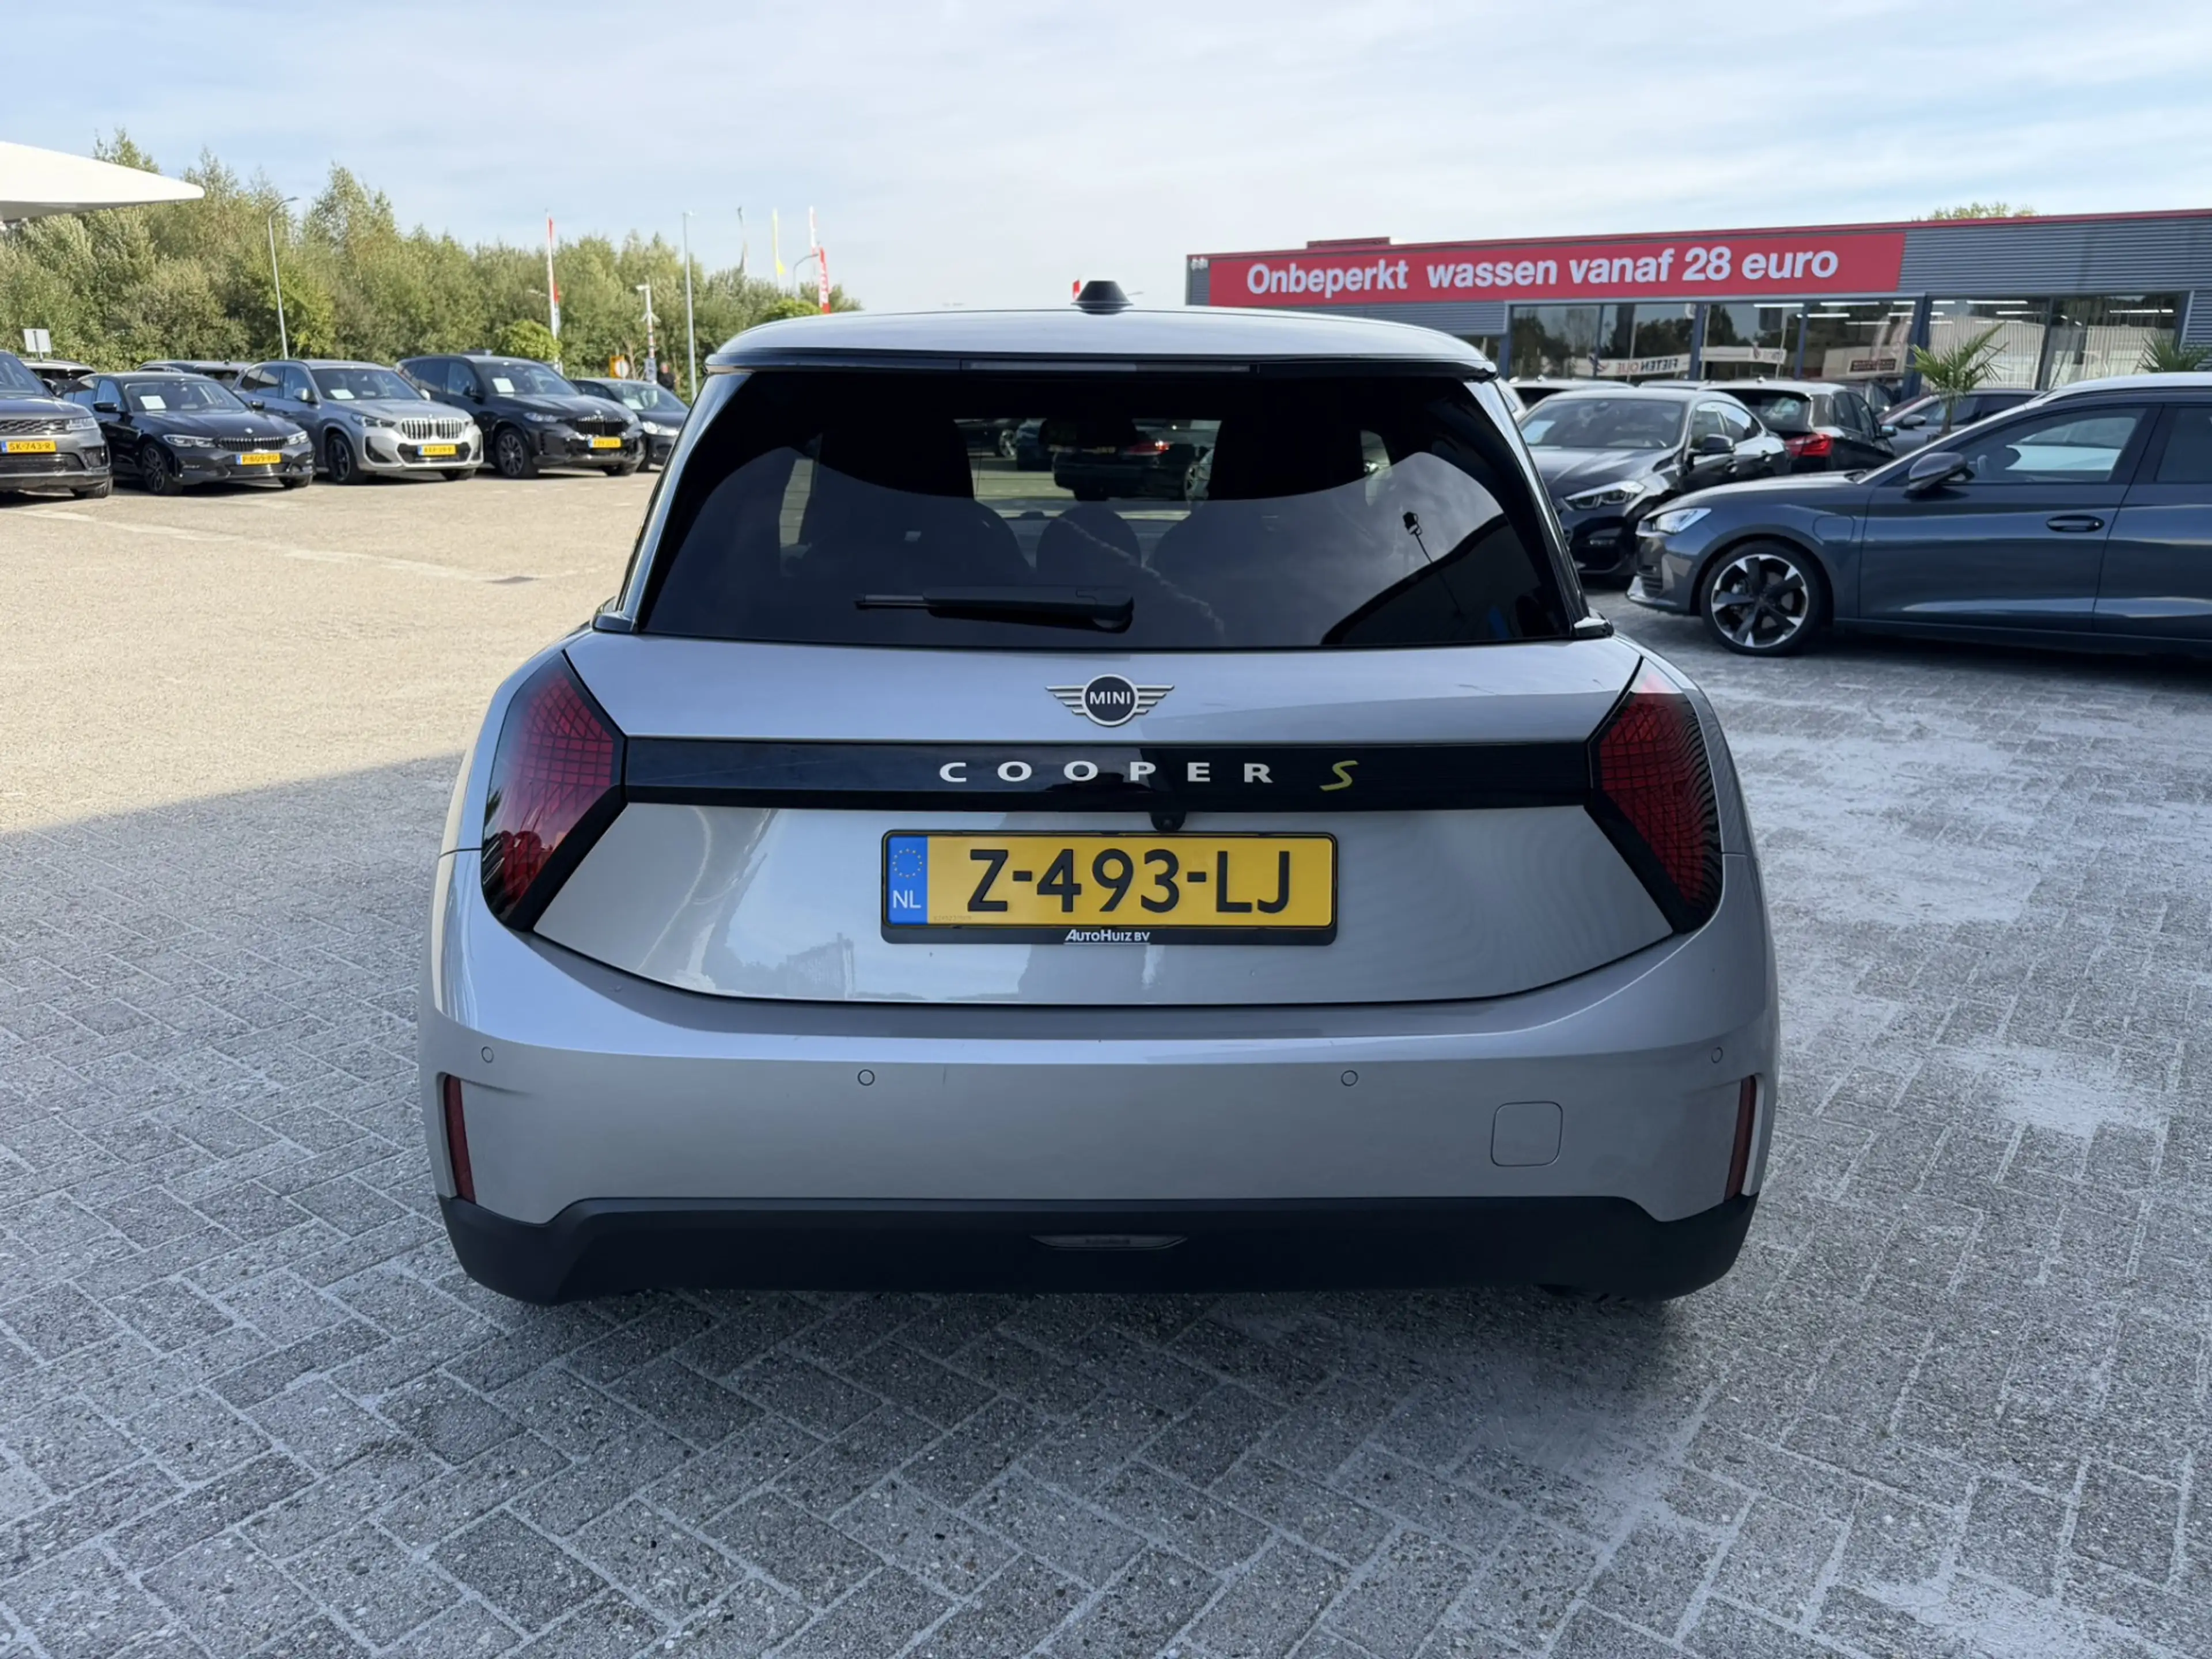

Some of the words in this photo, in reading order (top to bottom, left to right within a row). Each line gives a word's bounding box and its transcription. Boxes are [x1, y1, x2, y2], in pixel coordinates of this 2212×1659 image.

[1247, 259, 1409, 298] Onbeperkt
[1427, 259, 1557, 287] wassen
[1569, 248, 1675, 283] vanaf
[1682, 246, 1732, 281] 28
[1741, 250, 1839, 280] euro
[1089, 691, 1131, 704] MINI
[940, 761, 1274, 783] COOPER
[1319, 760, 1358, 791] S
[967, 849, 1290, 913] Z-493-LJ
[893, 891, 921, 908] NL
[1134, 931, 1150, 941] BV
